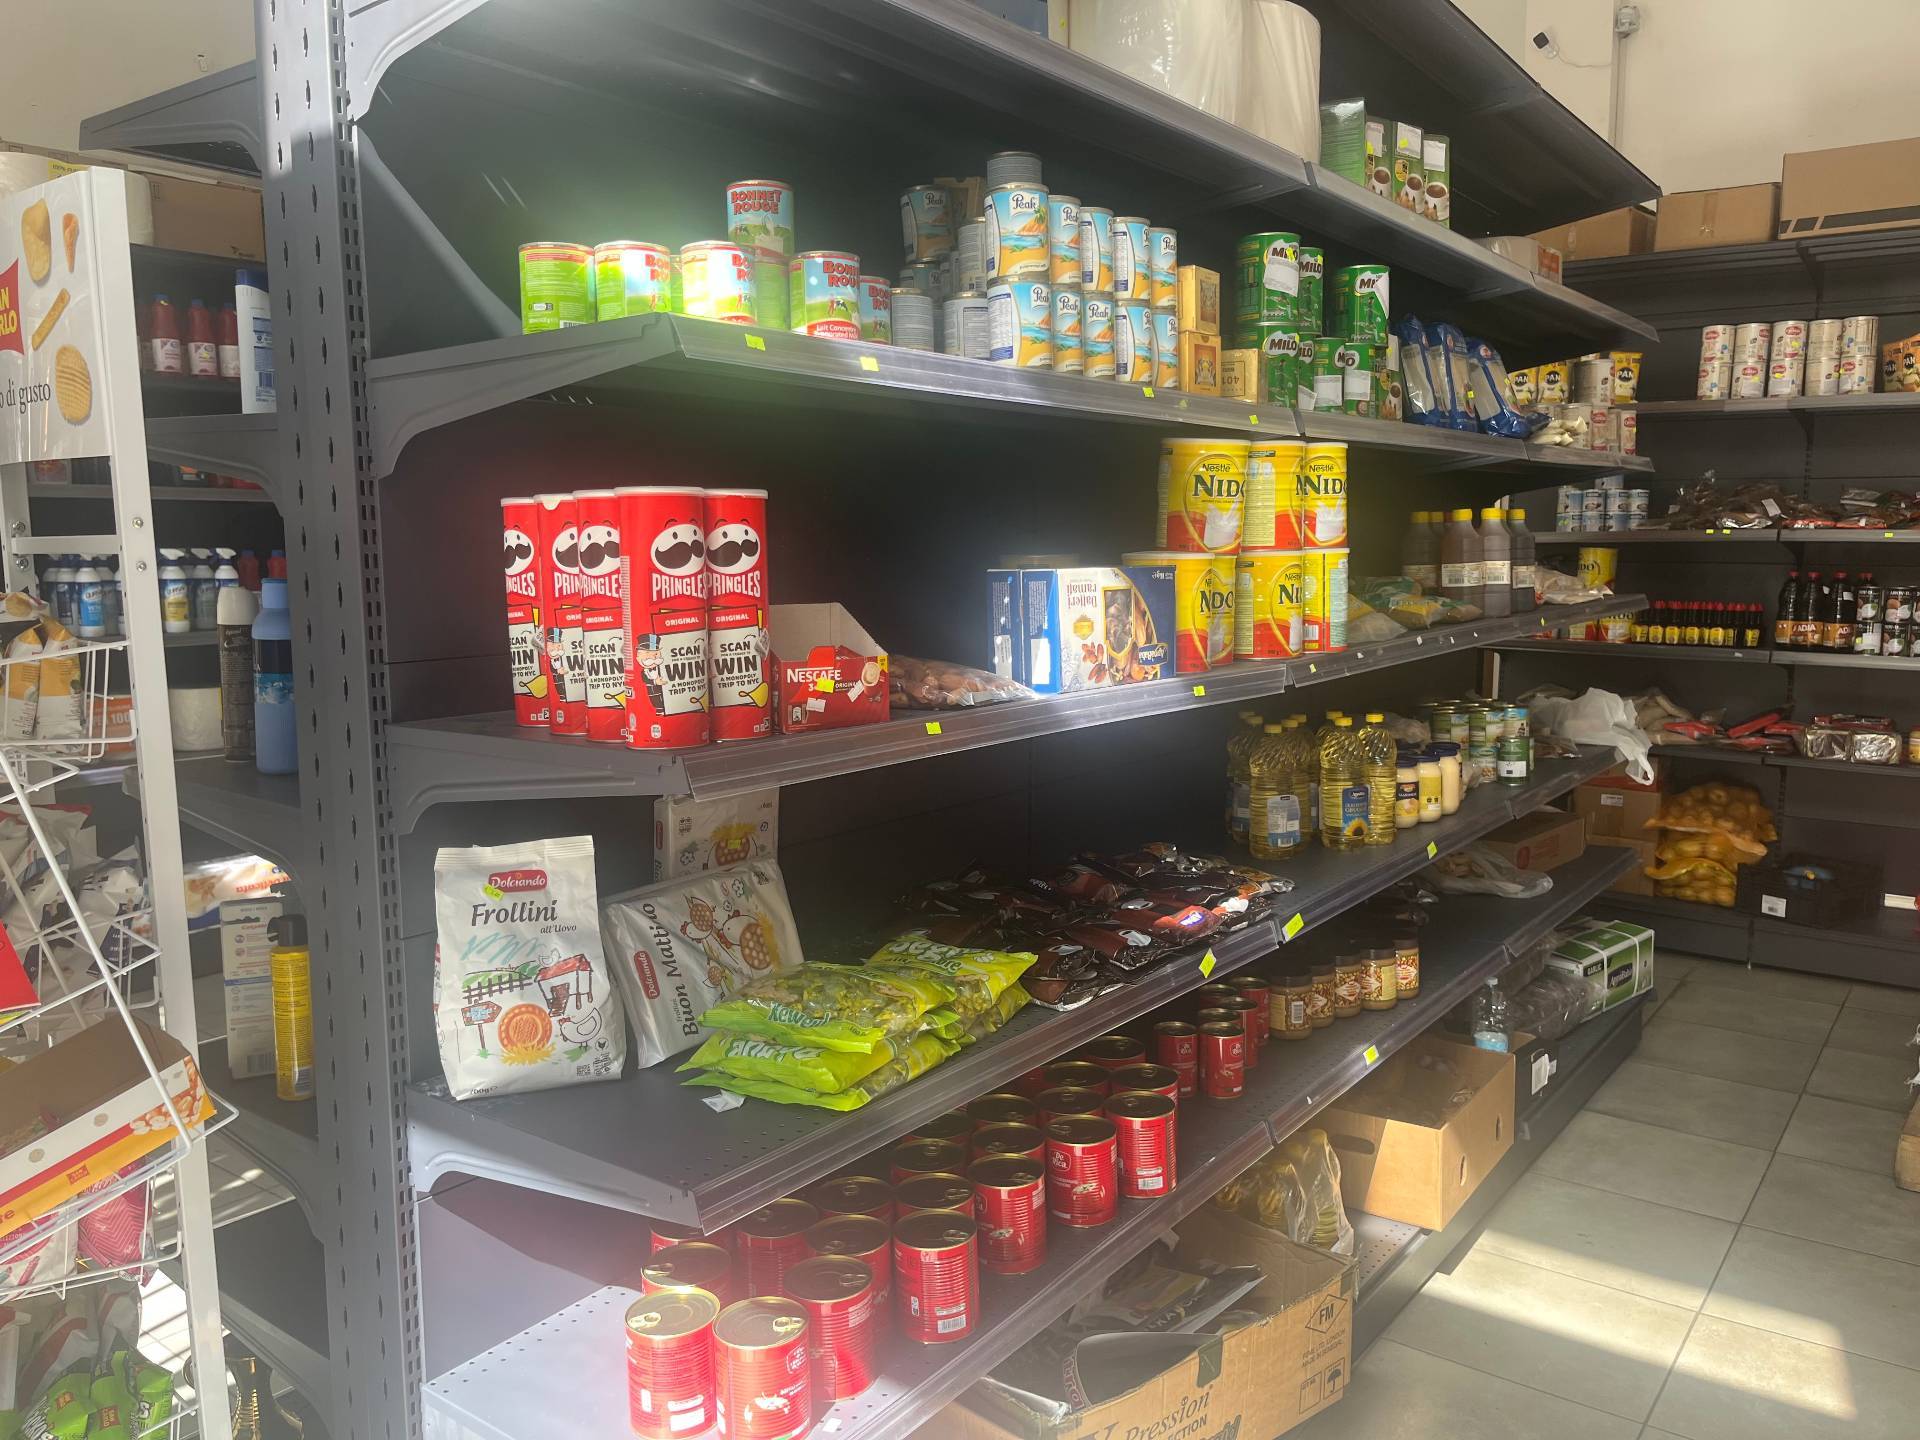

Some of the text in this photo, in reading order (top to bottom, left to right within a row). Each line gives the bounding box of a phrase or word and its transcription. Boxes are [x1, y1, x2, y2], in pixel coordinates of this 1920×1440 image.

[731, 190, 782, 204] BONNET
[1012, 193, 1037, 210] Peak
[734, 201, 779, 215] ROUGE
[1271, 247, 1298, 260] MIO
[823, 260, 860, 275] BONN
[1299, 261, 1322, 274] MILO
[828, 274, 860, 289] ROU
[1358, 277, 1377, 289] MI
[0, 287, 10, 310] AN
[1088, 303, 1109, 318] Peak
[0, 310, 18, 337] RLO
[1269, 338, 1297, 351] MILO
[1616, 368, 1634, 379] PAN
[6, 378, 51, 415] di gusto
[1580, 562, 1595, 572] DO
[506, 571, 536, 597] NGLES
[1284, 573, 1301, 582] Nest
[553, 571, 581, 599] PRIN
[580, 572, 622, 599] PRINGLE
[1279, 583, 1302, 606] NI
[566, 613, 582, 621] ORIG
[665, 616, 700, 627] ORIGINAL
[715, 613, 750, 623] ORIGINAL
[571, 640, 583, 651] SC
[589, 643, 616, 655] SCAN
[670, 644, 701, 658] SCAN
[720, 640, 751, 653] SCAN
[586, 657, 625, 677] WIN
[664, 659, 706, 682] WIN
[714, 654, 758, 676] WIN
[594, 675, 624, 683] MONOPOLY
[678, 678, 706, 688] MONOPOLY
[717, 677, 760, 689] TRIP TO NYC
[725, 673, 757, 682] MONOPOLY
[835, 680, 857, 689] ORIGIN
[668, 687, 687, 696] TRIP
[687, 686, 697, 694] TO
[490, 874, 547, 889] Dolciando
[471, 899, 559, 927] Frollini
[540, 923, 578, 935] all'Uovo
[675, 983, 700, 1037] Buon
[1320, 1303, 1335, 1325] FM
[1167, 1413, 1208, 1440] ECTION
